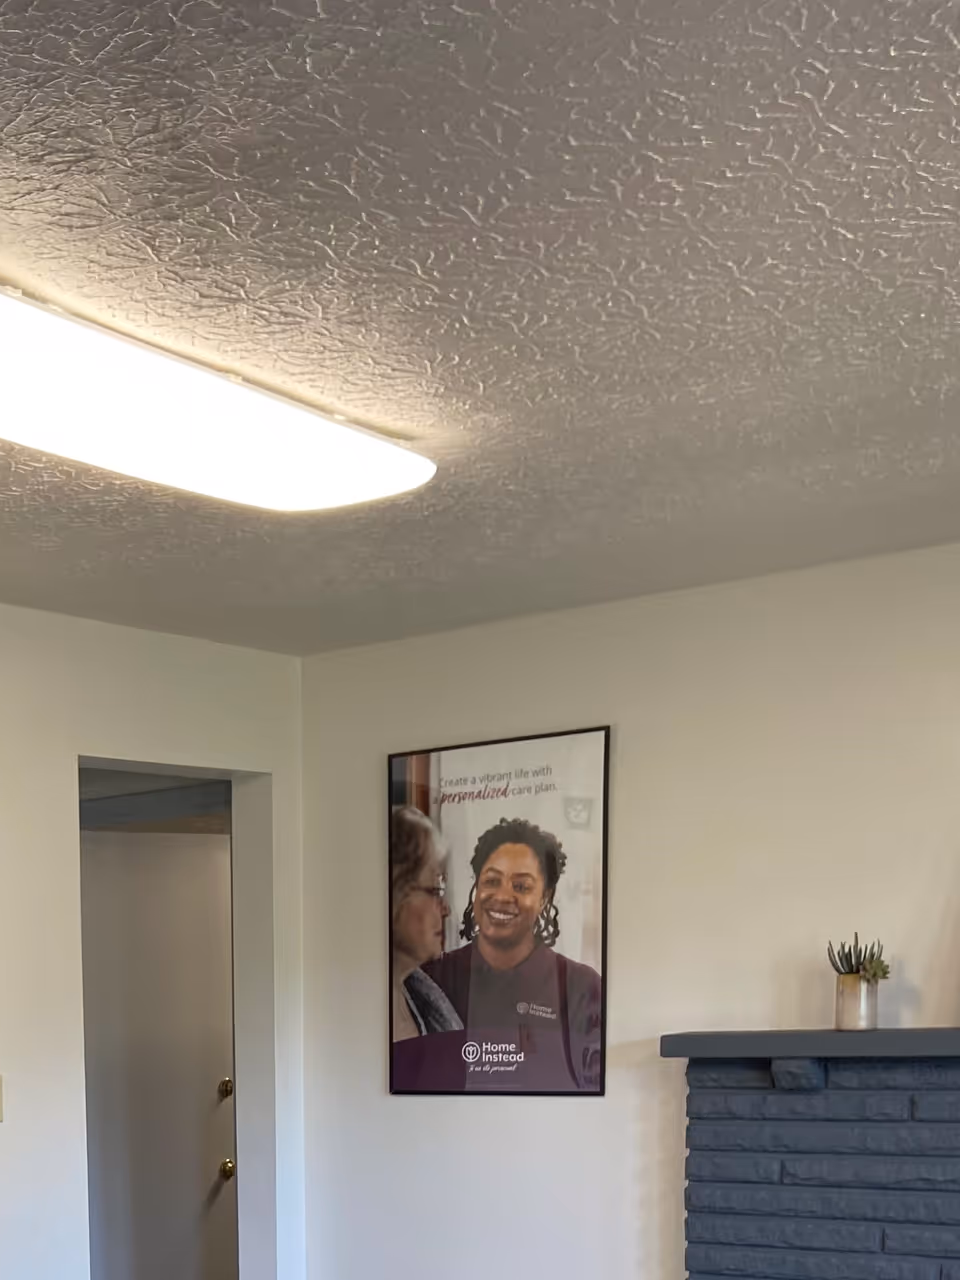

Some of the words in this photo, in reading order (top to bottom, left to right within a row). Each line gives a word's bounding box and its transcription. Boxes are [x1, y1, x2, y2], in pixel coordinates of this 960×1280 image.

[440, 777, 468, 788] Create
[480, 772, 512, 784] vibrant
[514, 768, 529, 779] life
[531, 765, 553, 778] with
[440, 782, 510, 804] personalized
[511, 786, 532, 796] care
[482, 1042, 516, 1052] Home
[482, 1052, 525, 1062] Instead
